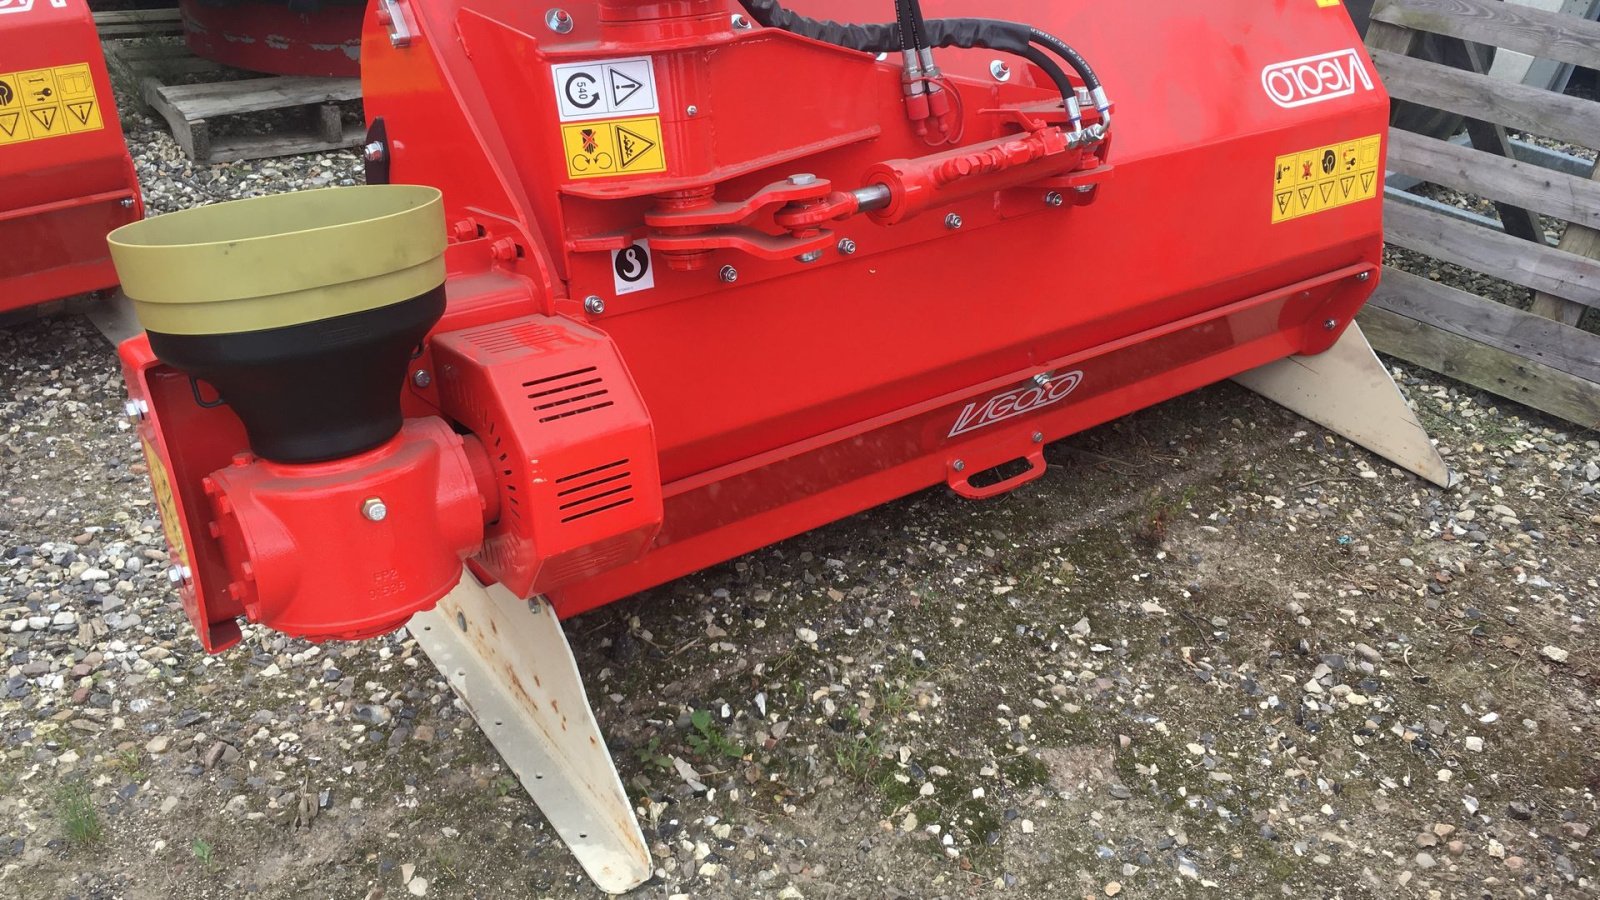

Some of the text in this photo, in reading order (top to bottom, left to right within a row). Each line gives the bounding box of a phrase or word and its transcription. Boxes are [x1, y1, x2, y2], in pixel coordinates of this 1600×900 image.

[576, 81, 589, 100] 540
[1261, 48, 1375, 109] VIGOLO
[947, 370, 1084, 438] VIGOLO
